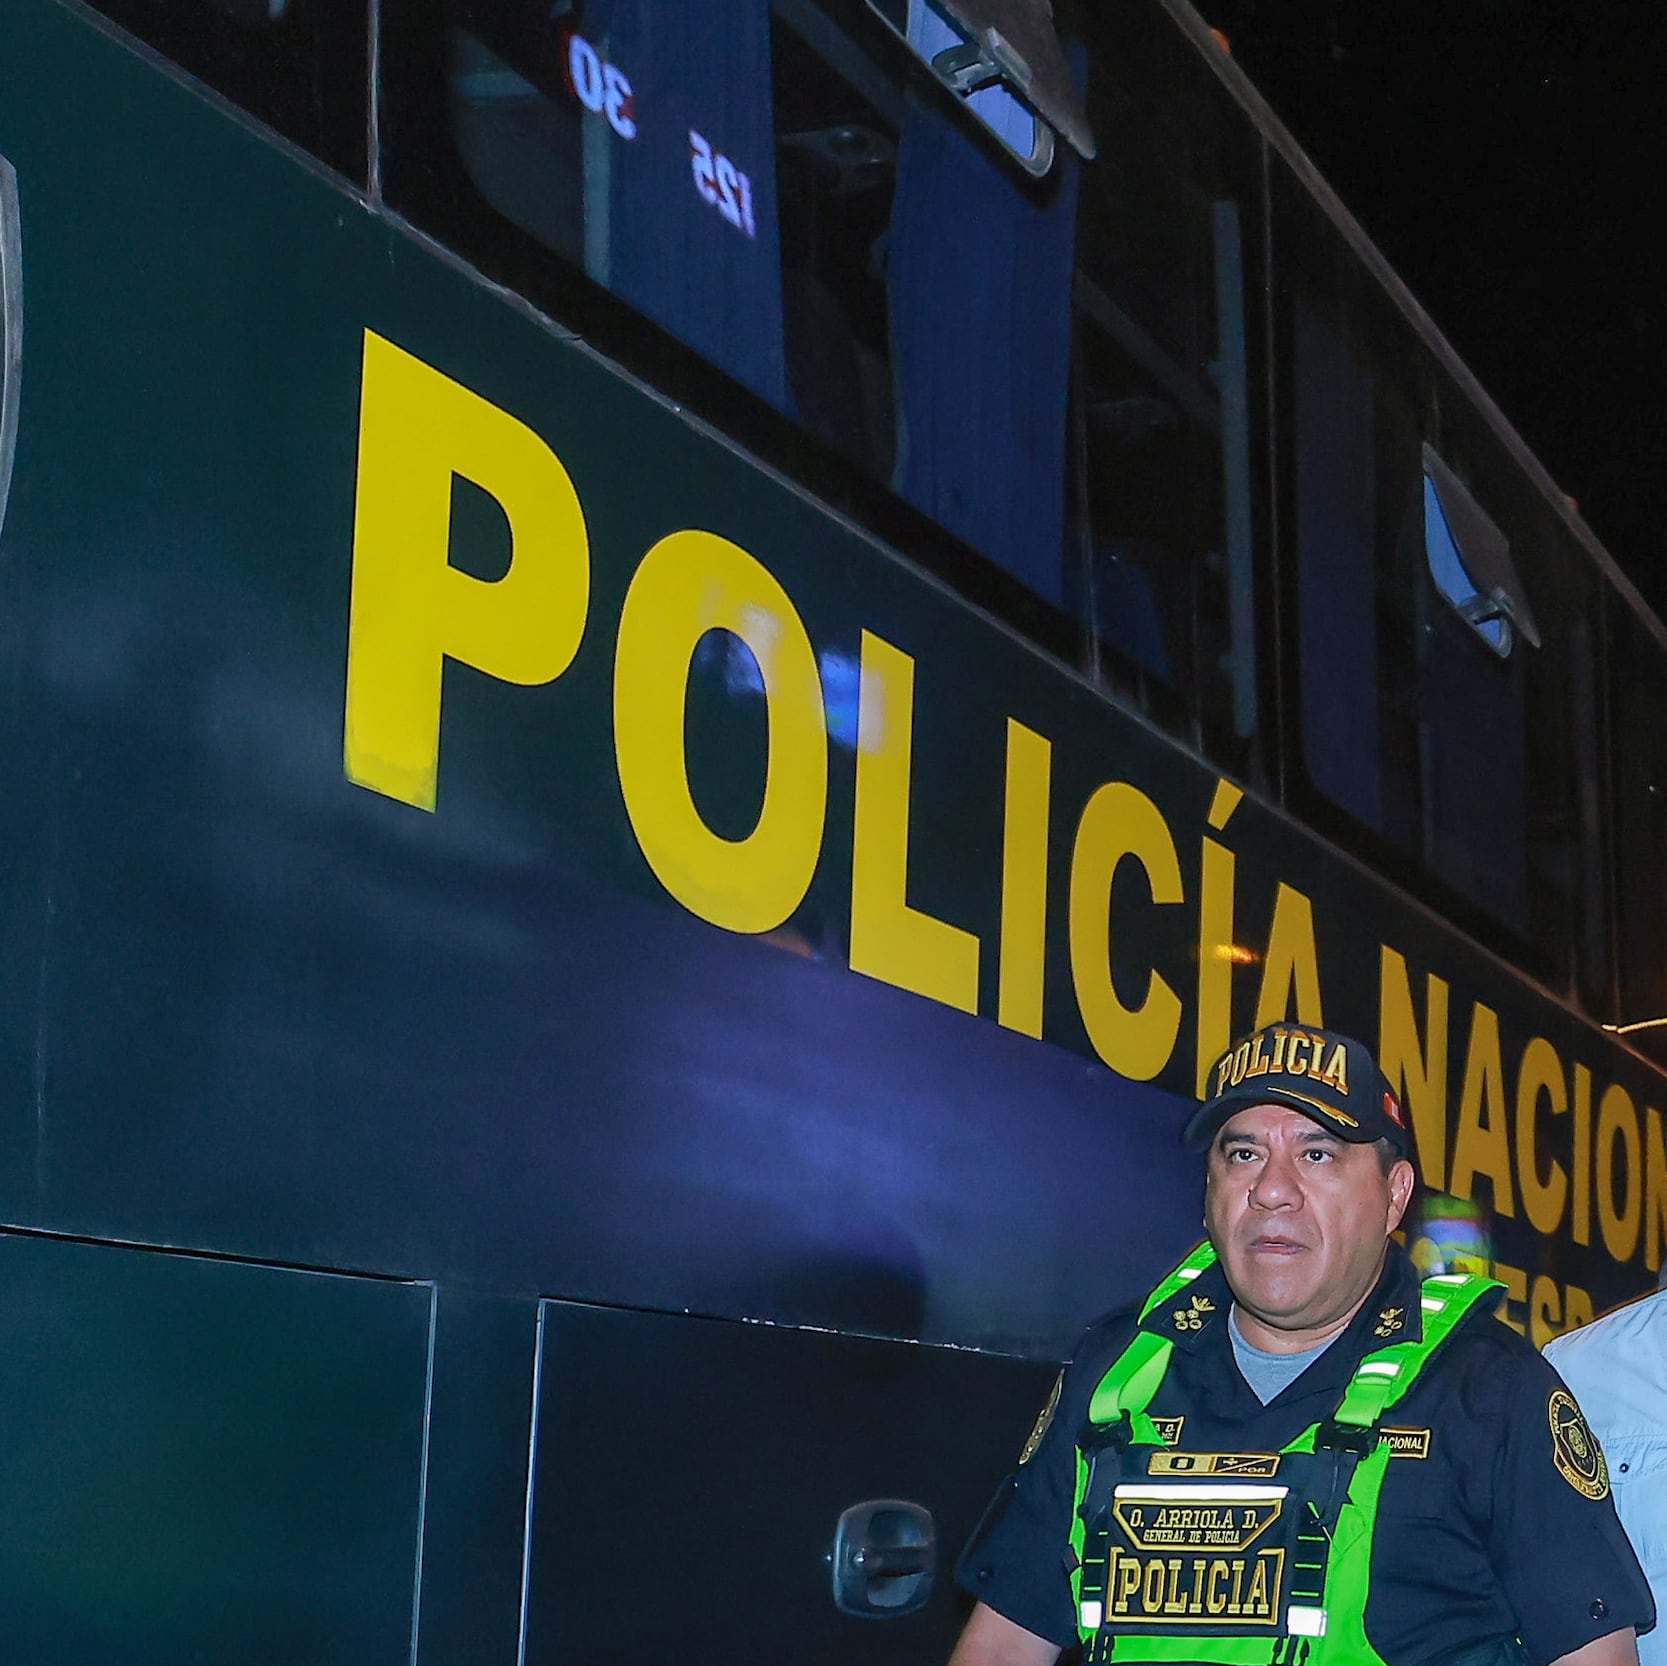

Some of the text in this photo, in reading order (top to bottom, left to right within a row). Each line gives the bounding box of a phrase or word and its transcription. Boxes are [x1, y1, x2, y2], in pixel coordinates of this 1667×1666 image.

[343, 327, 1325, 1102] POLICÍA
[1213, 1029, 1351, 1101] POLICIA
[1129, 1507, 1259, 1530] O. ARRIOLA D.
[1142, 1528, 1241, 1544] GENERAL DE POLICIA
[1114, 1557, 1270, 1615] POLICIA
